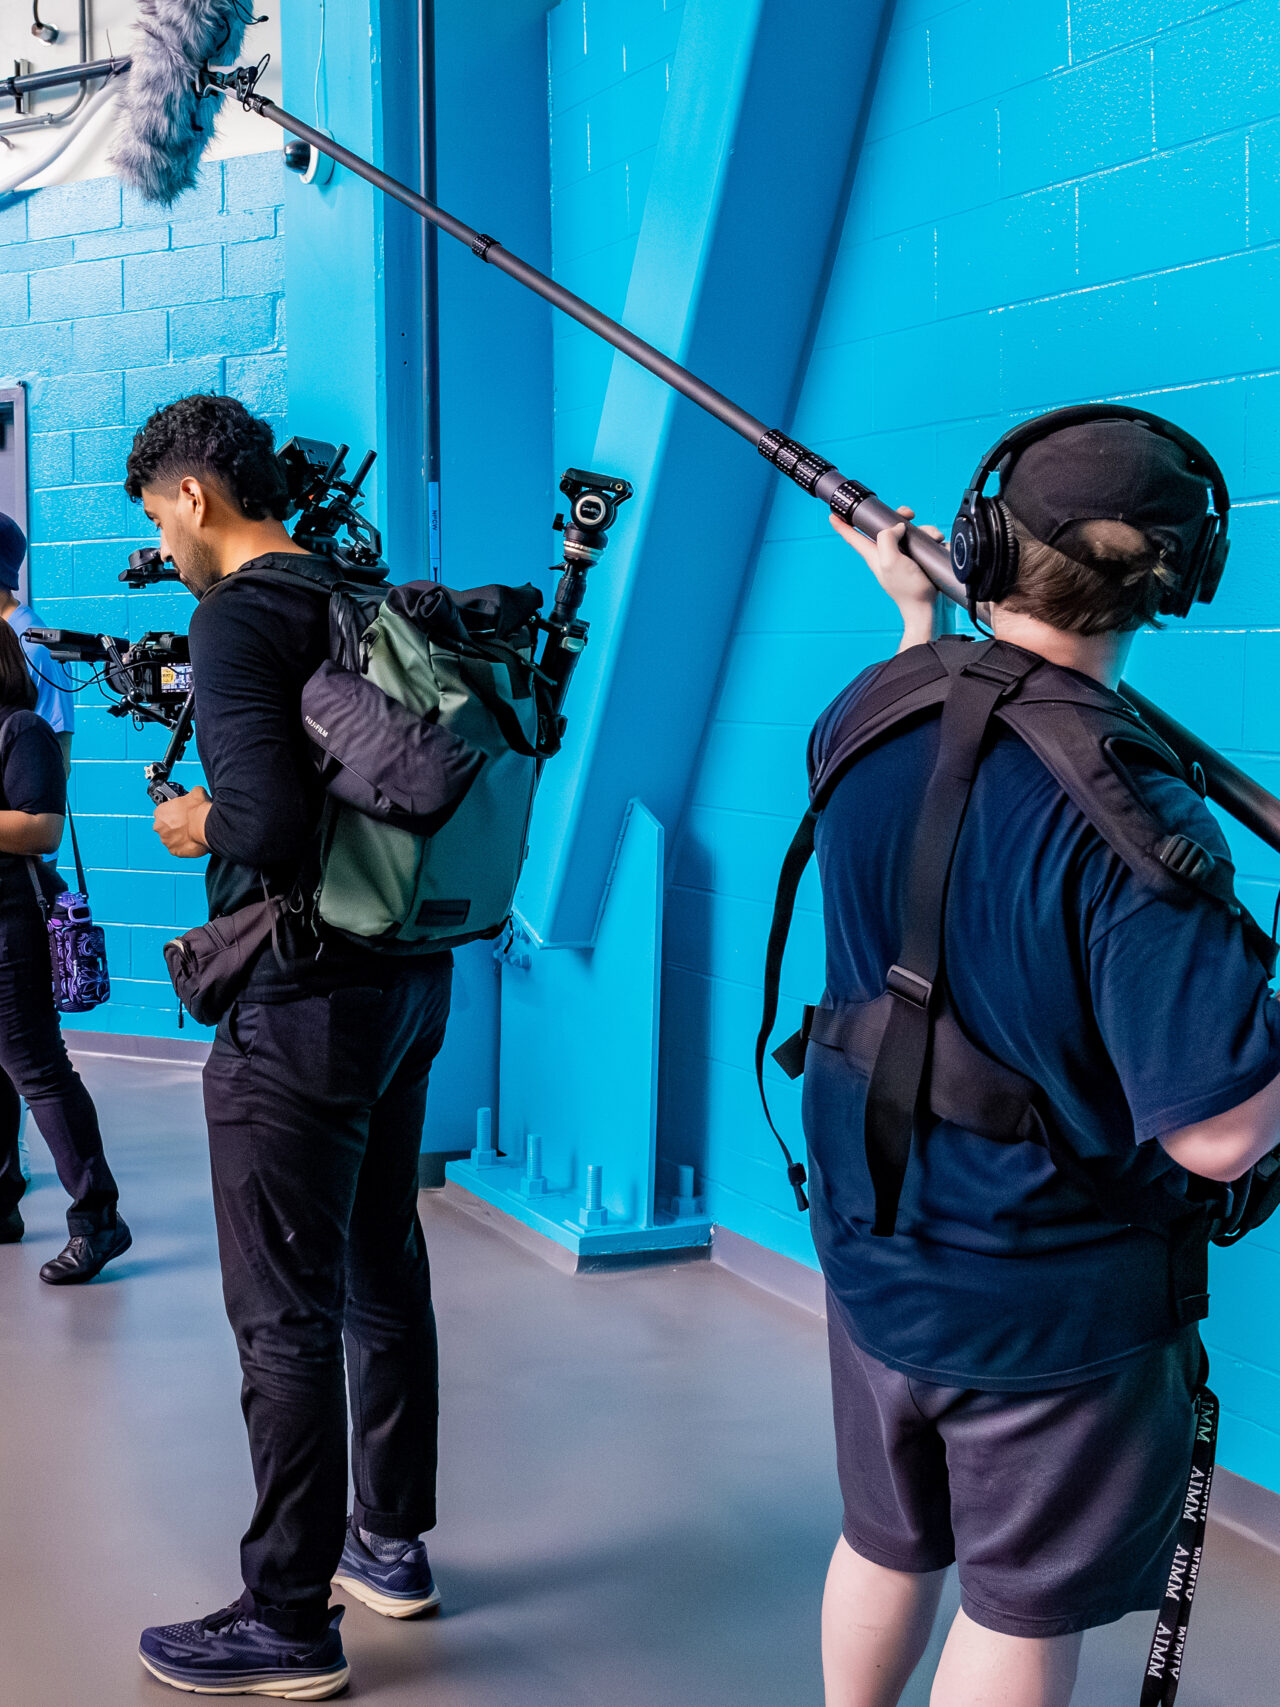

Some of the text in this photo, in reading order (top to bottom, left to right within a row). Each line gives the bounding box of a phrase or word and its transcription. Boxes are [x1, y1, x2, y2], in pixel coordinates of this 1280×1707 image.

[1196, 1401, 1215, 1443] IMM
[1182, 1465, 1205, 1523] AIMM
[1165, 1543, 1190, 1601] AIMM
[1147, 1621, 1173, 1679] AIMM
